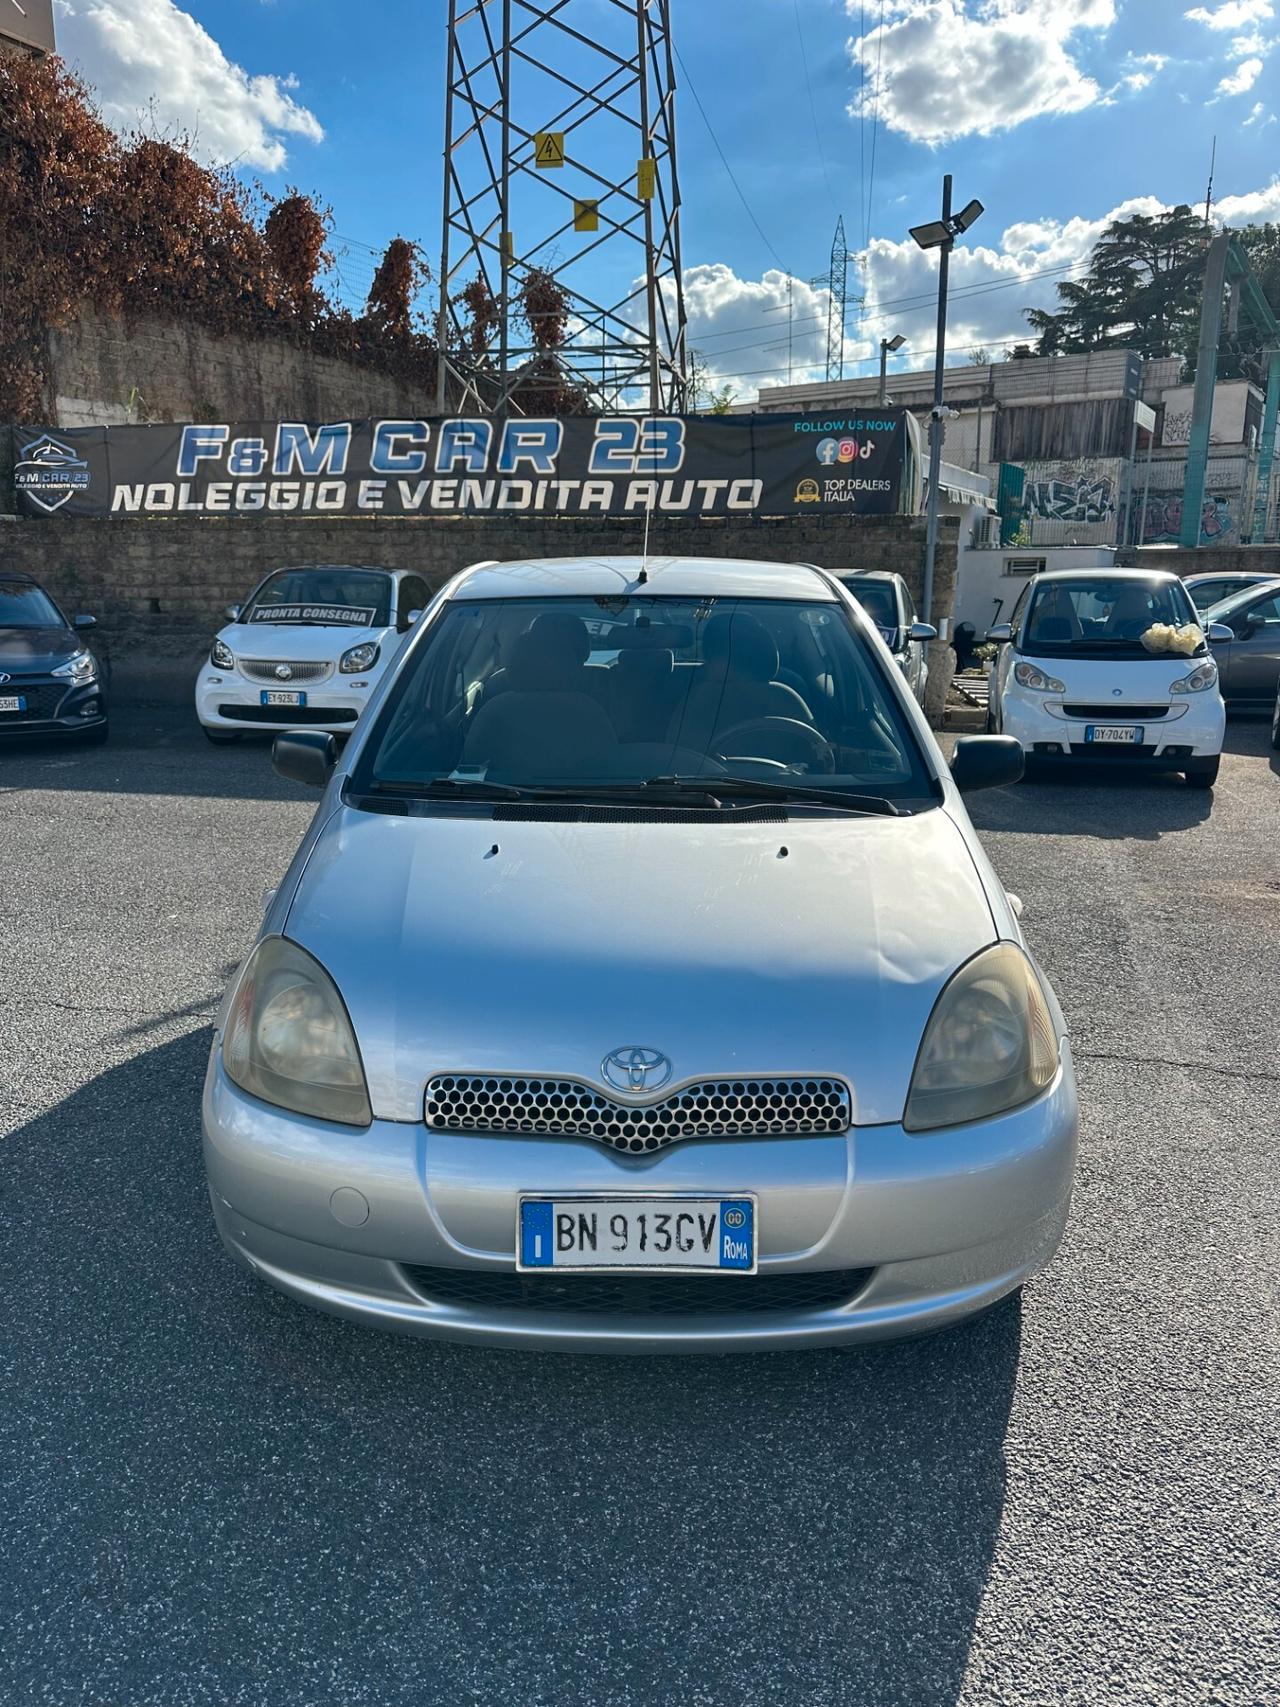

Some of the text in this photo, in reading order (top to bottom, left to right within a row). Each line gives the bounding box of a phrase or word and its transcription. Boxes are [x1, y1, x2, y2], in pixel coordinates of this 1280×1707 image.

[794, 420, 896, 433] FOLLOW US NOW
[177, 417, 686, 477] F&M CAR 23
[42, 473, 70, 483] CAR
[74, 473, 89, 482] 23
[824, 479, 891, 491] TOP DEALERS
[111, 478, 764, 511] NOLEGGIO E VENDITA AUTO
[824, 491, 855, 502] ITALIA
[256, 608, 367, 622] PRONTA CONSEGNA
[728, 1212, 742, 1225] 00
